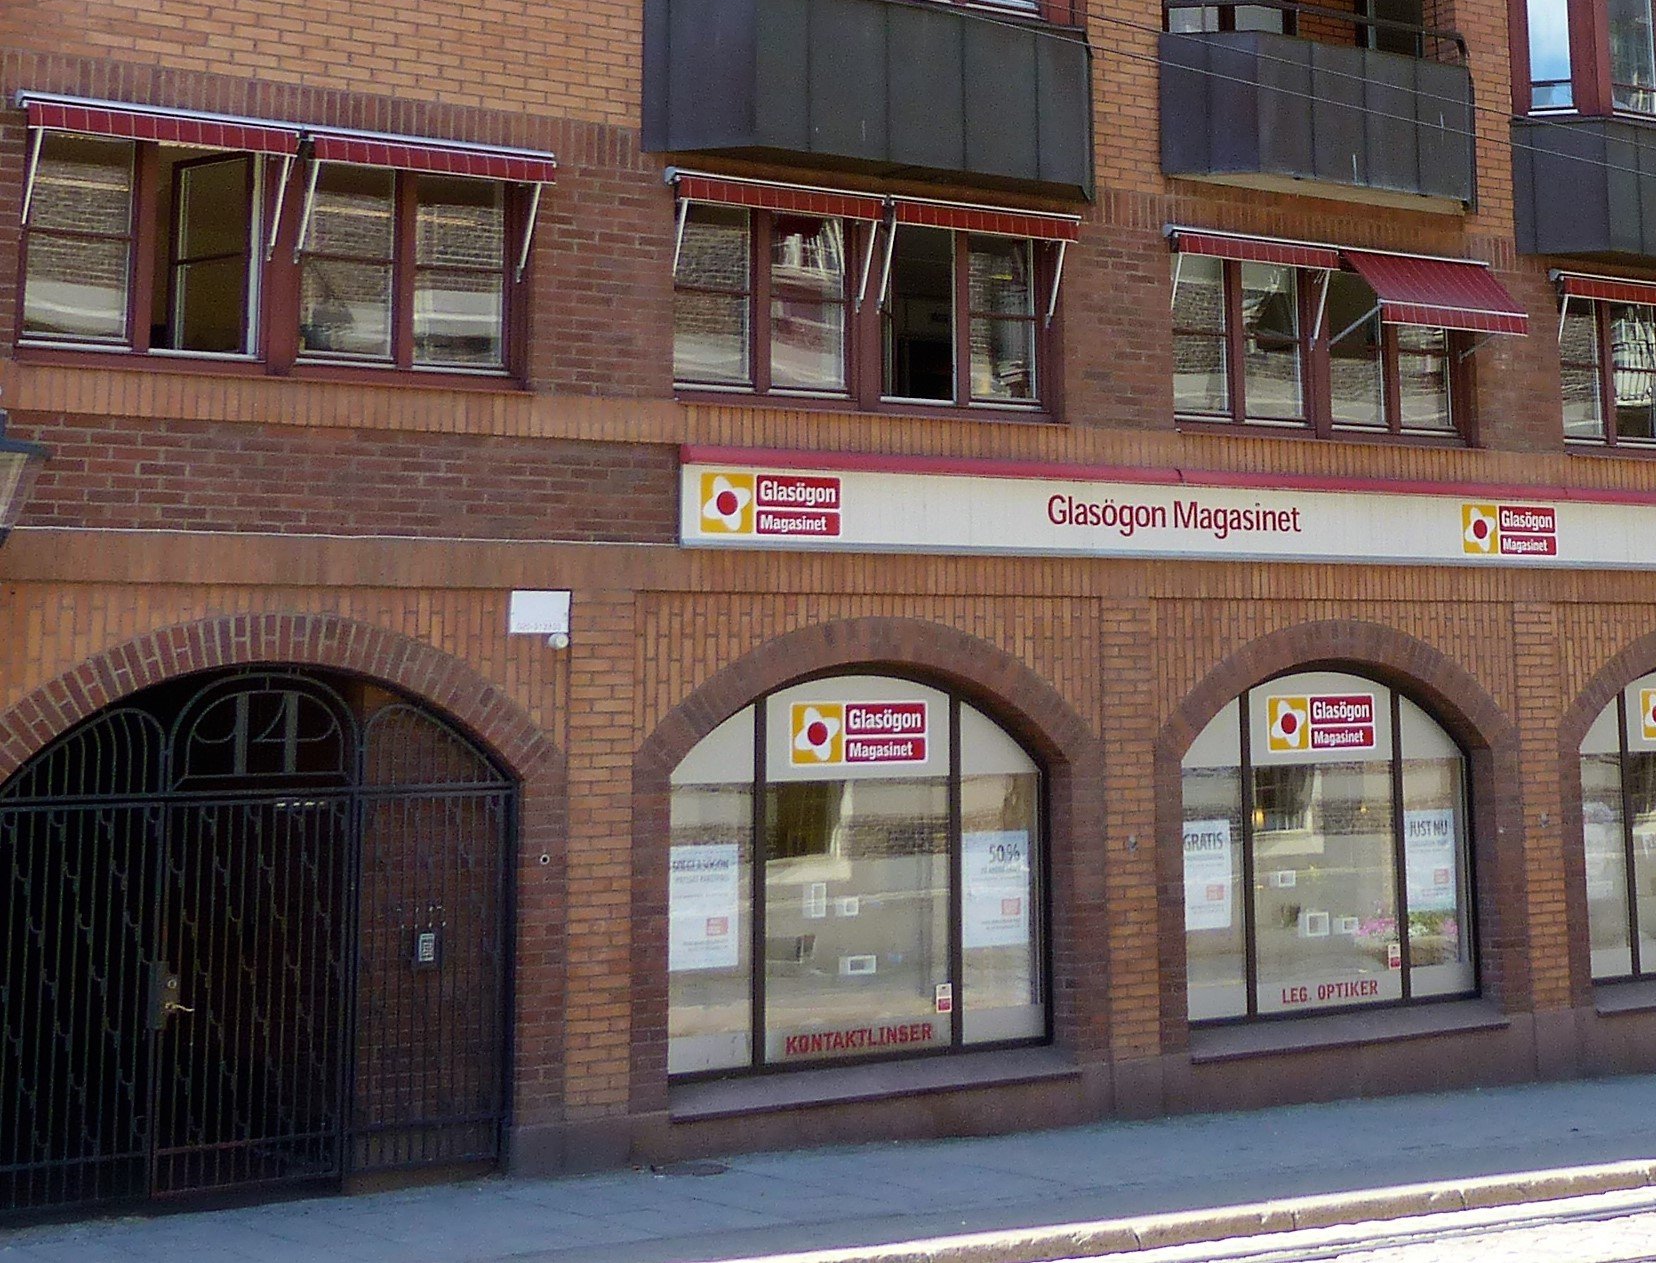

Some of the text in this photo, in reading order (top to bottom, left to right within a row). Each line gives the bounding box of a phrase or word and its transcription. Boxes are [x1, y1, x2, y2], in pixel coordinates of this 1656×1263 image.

[760, 479, 836, 506] Glasögon
[760, 512, 827, 534] Magasinet
[1047, 493, 1302, 539] Glasögon Magasinet
[1501, 509, 1553, 533] Glasögon
[1502, 537, 1548, 555] Magasinet
[848, 708, 922, 733] Glasögon
[1312, 700, 1370, 721] Glasögon
[1313, 730, 1364, 746] Magasinet
[848, 741, 914, 762] Magasinet
[1410, 819, 1448, 837] JUST NU
[1184, 832, 1223, 852] GRATIS
[1281, 979, 1378, 1004] LEG. OPTIKER
[785, 1022, 933, 1054] KONTAKTLINSER
